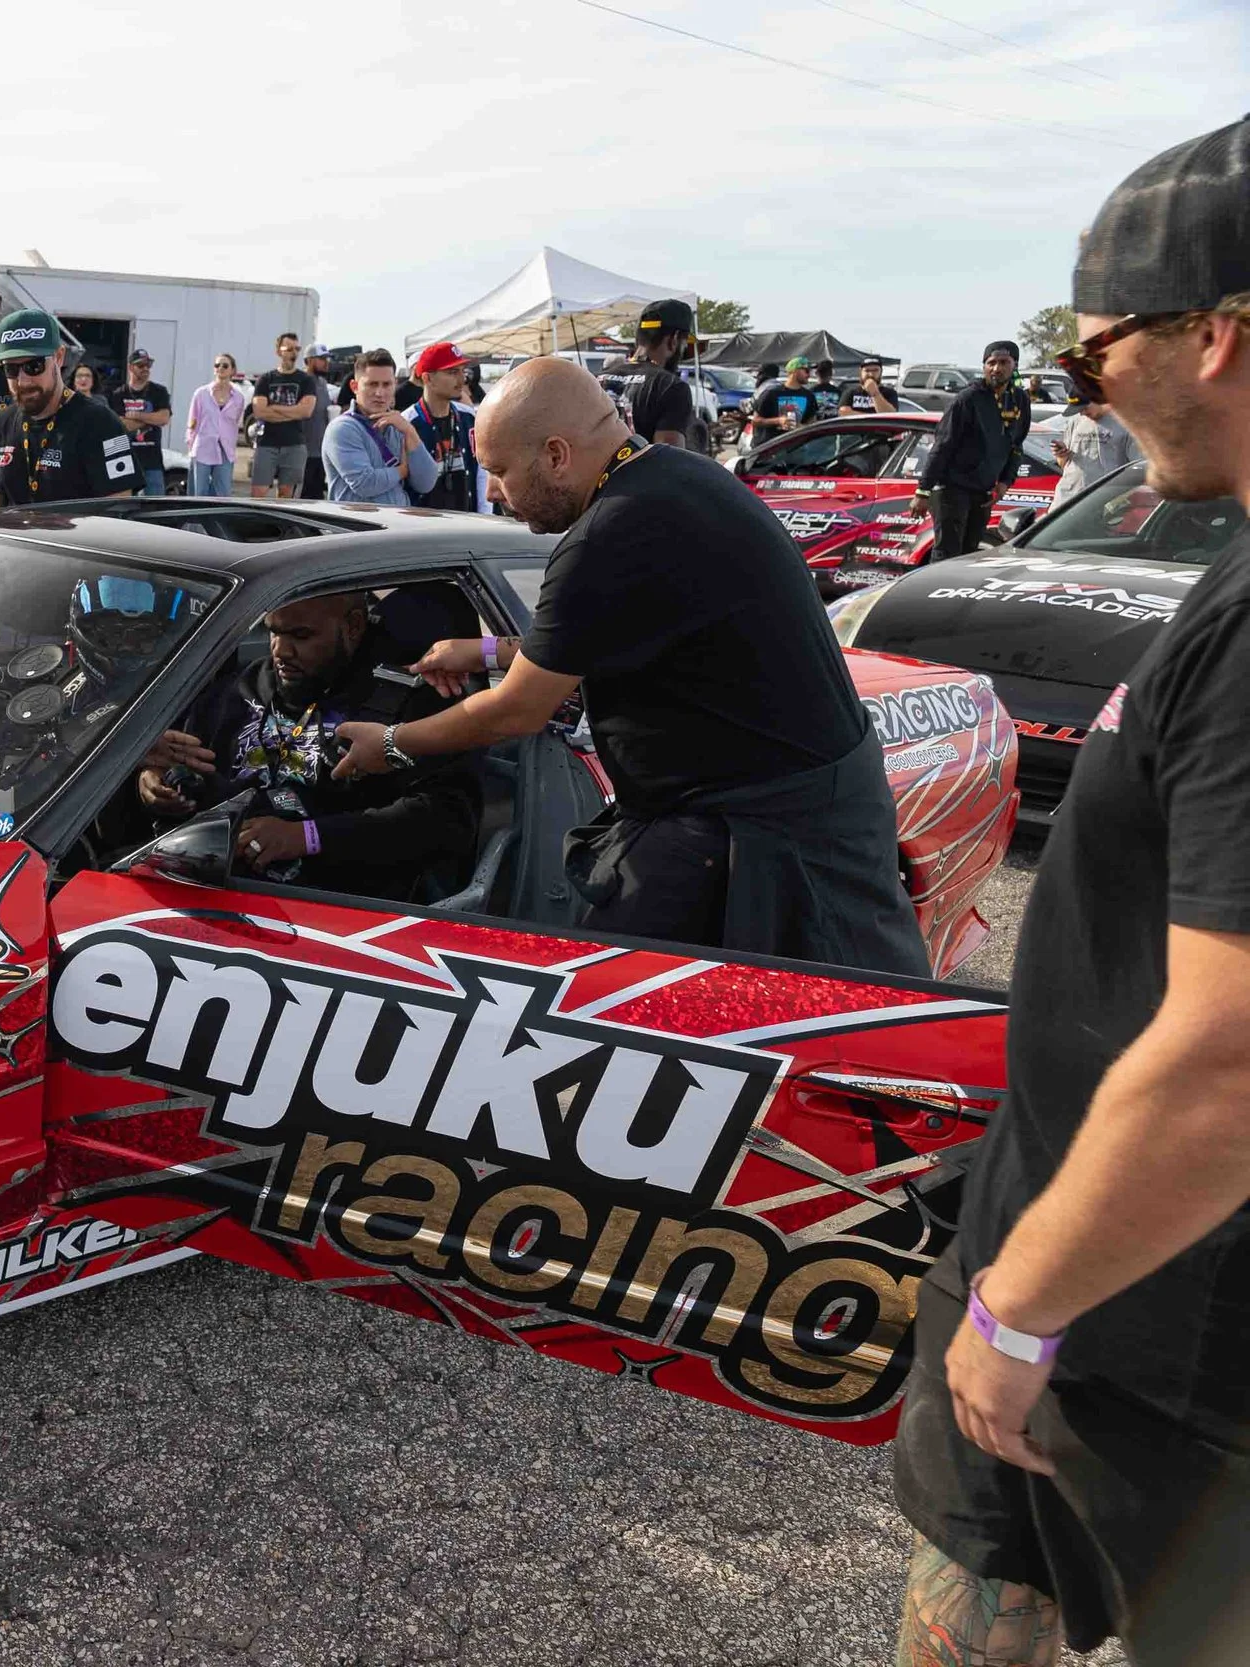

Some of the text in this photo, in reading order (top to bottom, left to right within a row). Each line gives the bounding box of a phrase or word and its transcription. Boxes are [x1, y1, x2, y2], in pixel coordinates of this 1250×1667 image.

[1, 328, 46, 343] RAYS
[856, 546, 905, 557] TRILOGY
[928, 588, 1179, 623] DRIFT ACADEM
[983, 577, 1184, 610] TEXAS
[867, 688, 978, 742] RACING
[887, 744, 959, 771] COILOVERS
[54, 941, 750, 1194] enjuku
[278, 1131, 920, 1390] racing
